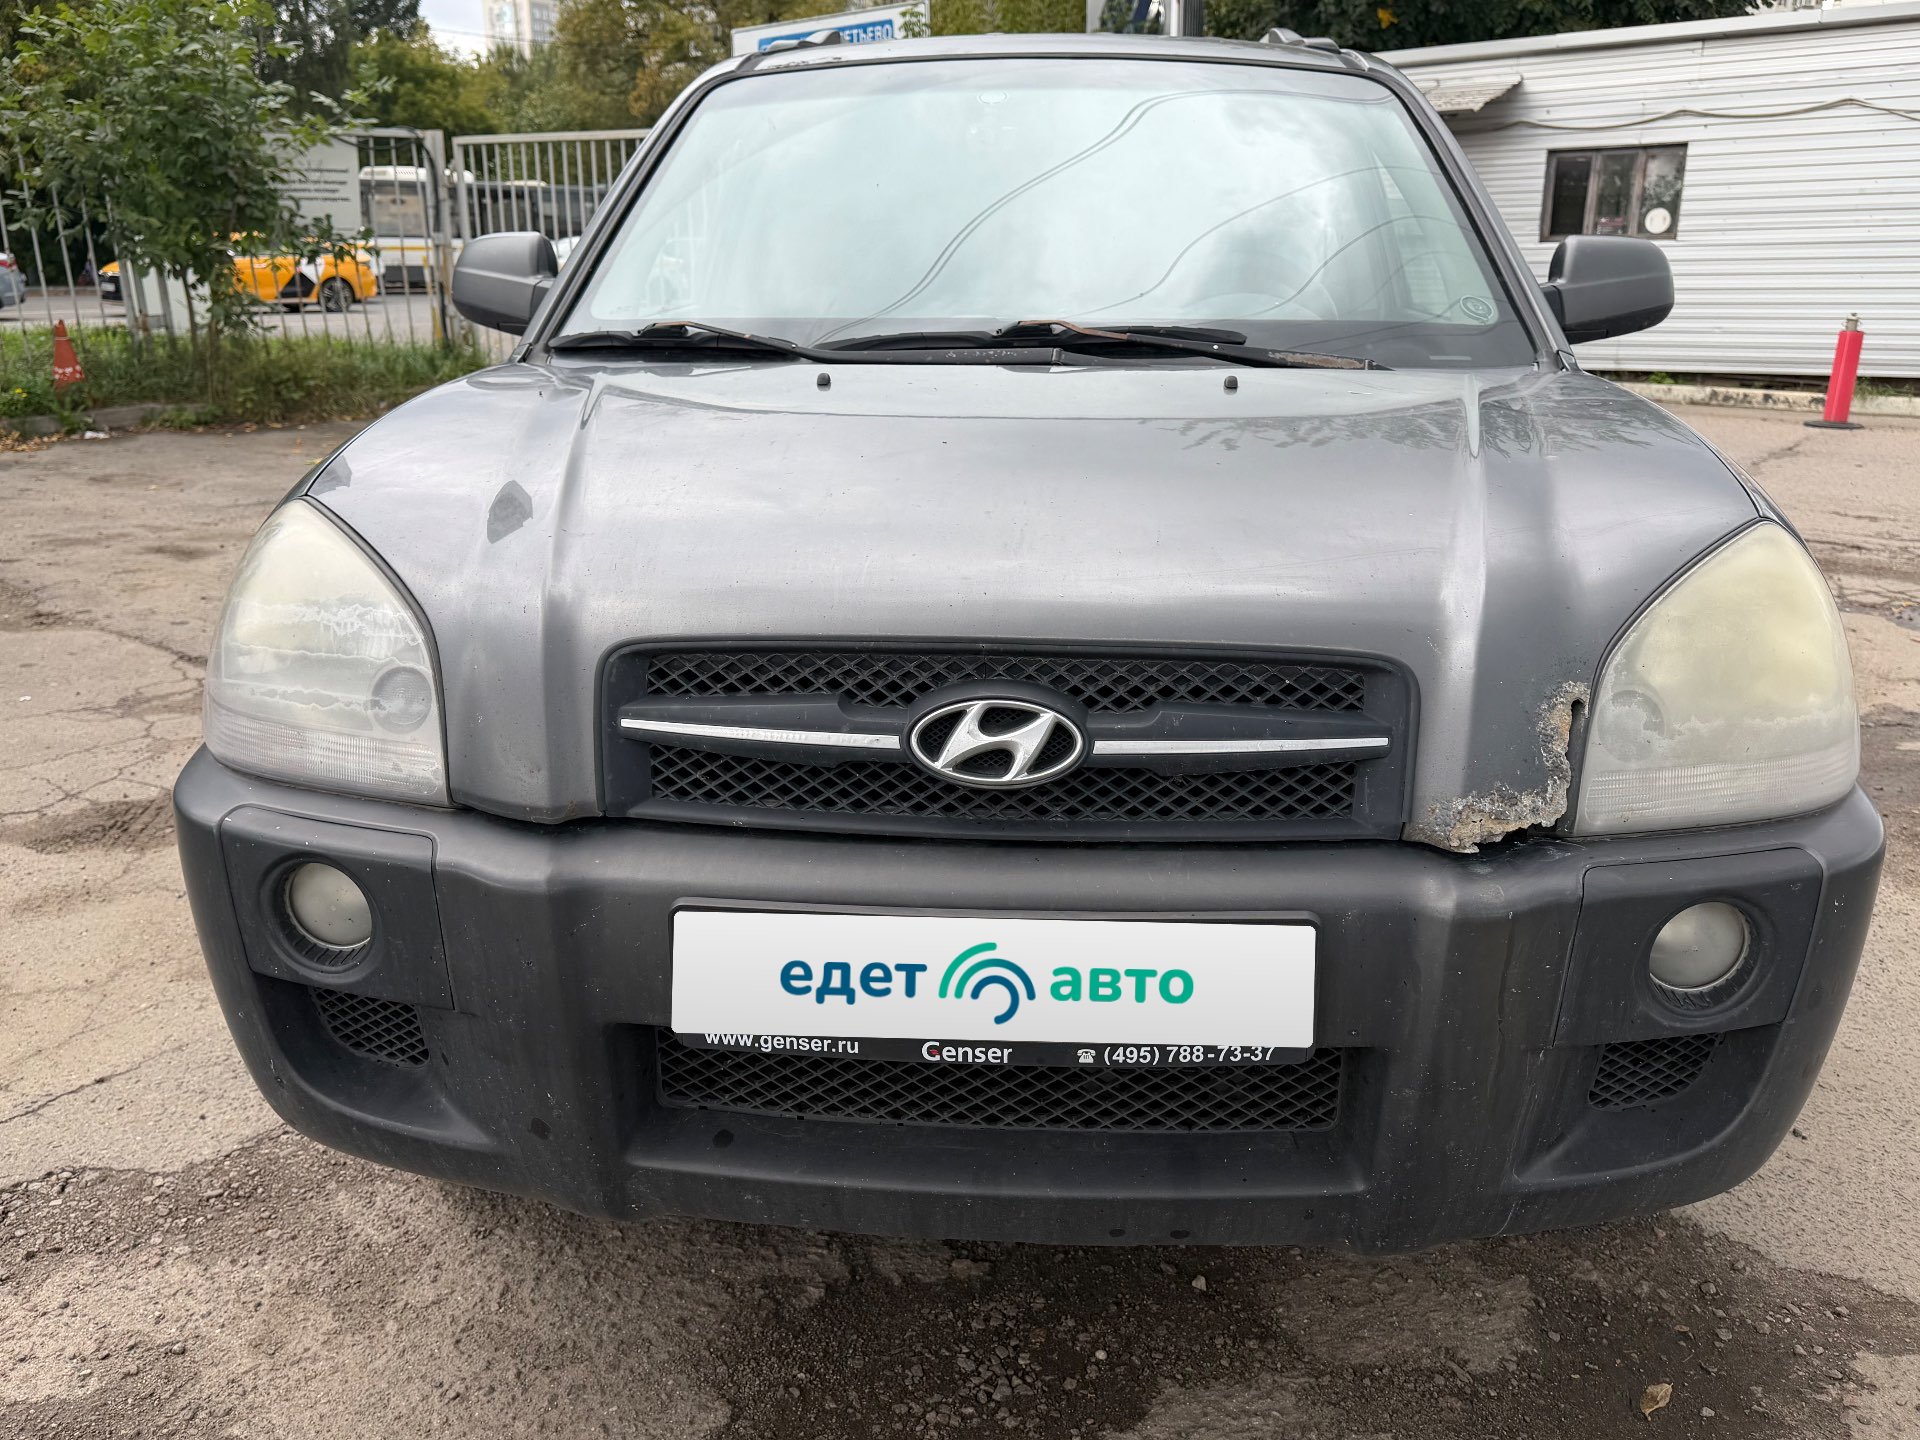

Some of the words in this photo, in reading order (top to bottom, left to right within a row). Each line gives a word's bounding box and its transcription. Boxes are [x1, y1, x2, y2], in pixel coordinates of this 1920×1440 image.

[840, 24, 893, 43] ЕТЬЕВО
[704, 1033, 859, 1054] www.genser.ru
[921, 1041, 1013, 1064] Genser
[1103, 1046, 1160, 1065] (495)
[1166, 1045, 1276, 1063] 788-73-37
